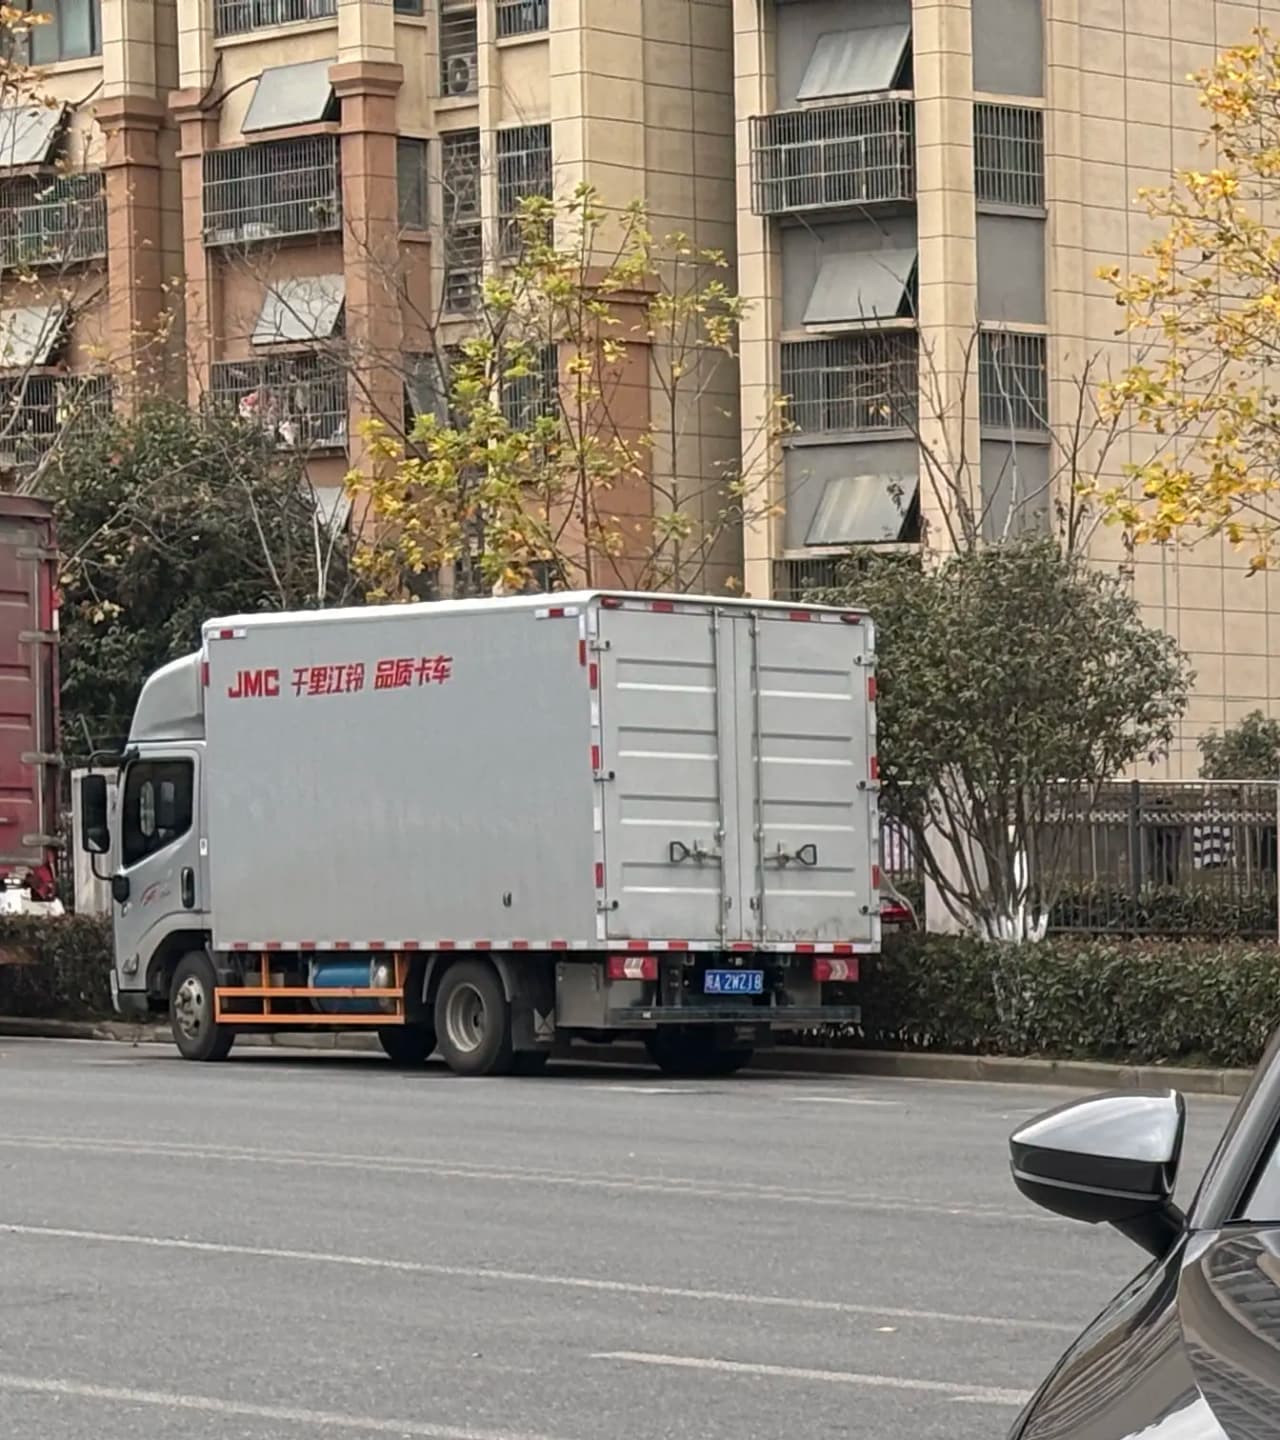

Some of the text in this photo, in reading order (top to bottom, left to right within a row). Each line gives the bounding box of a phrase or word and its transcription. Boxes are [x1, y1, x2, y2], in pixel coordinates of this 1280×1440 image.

[228, 655, 452, 699] JMC 千里江铃 品质卡车
